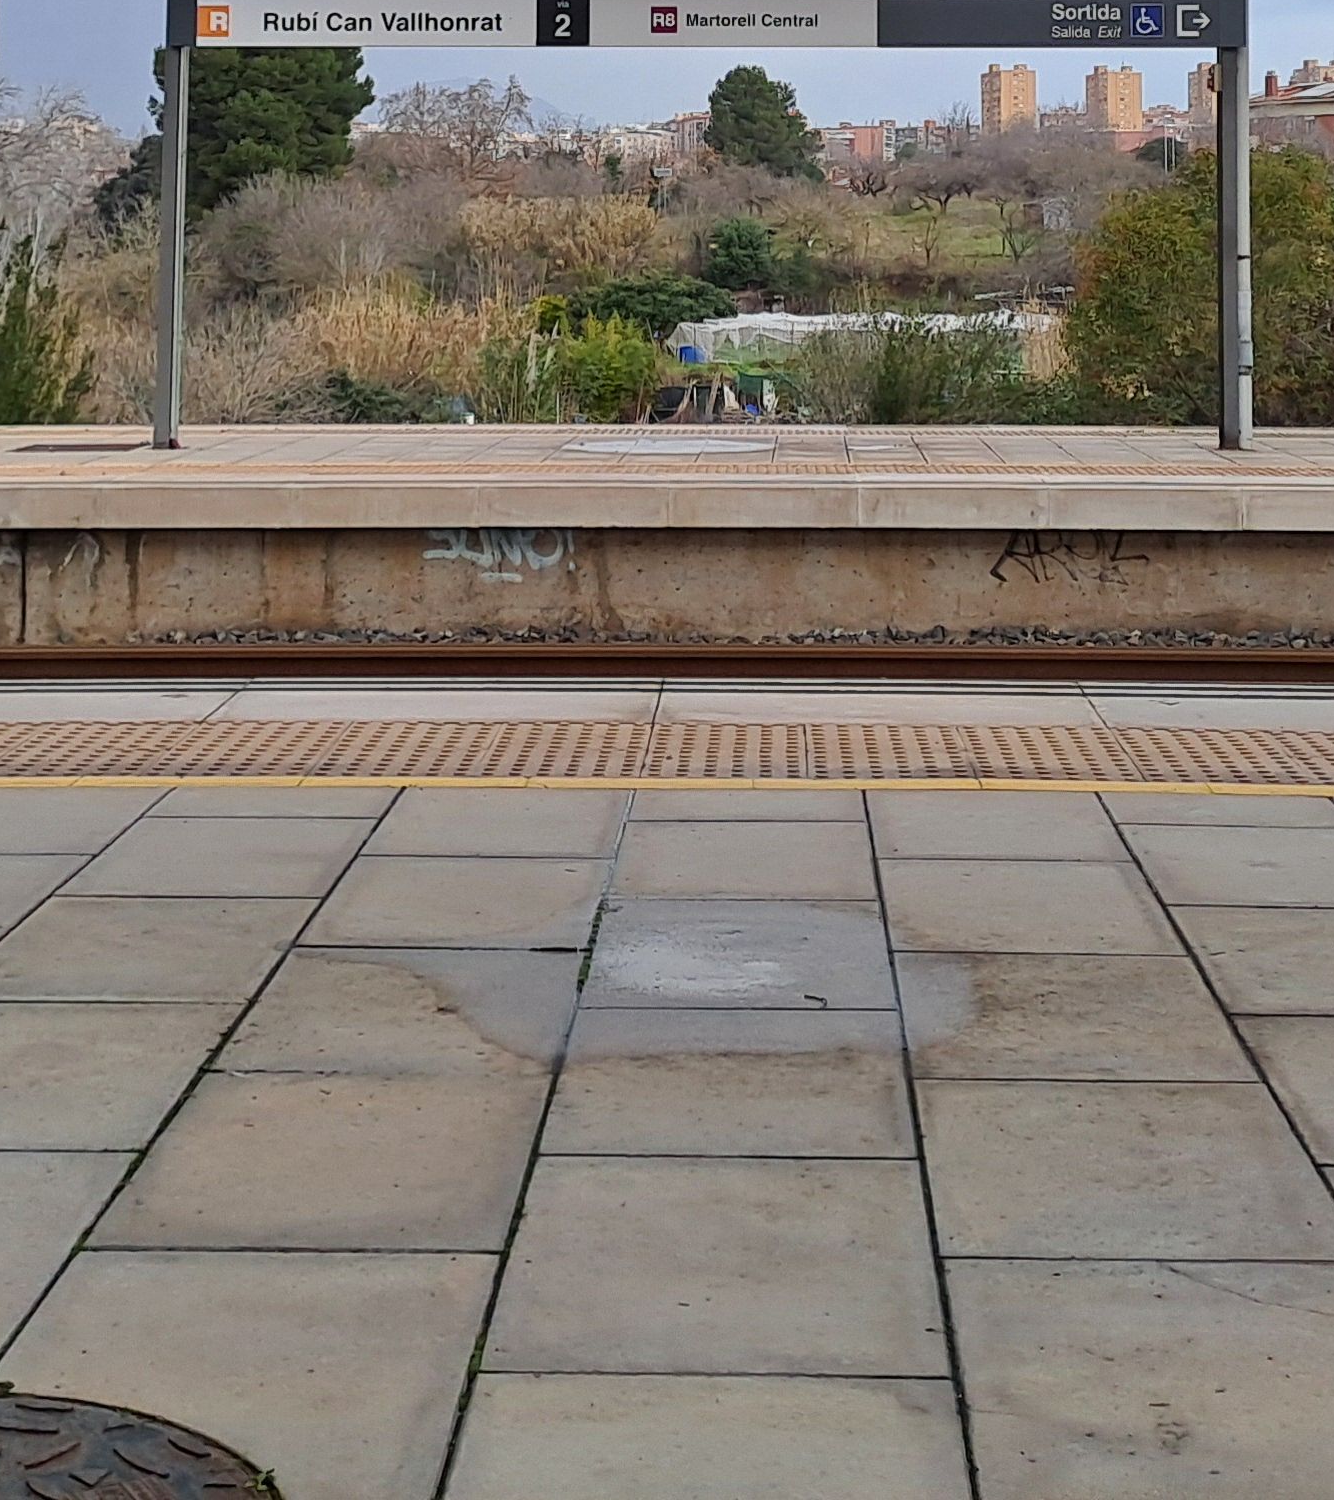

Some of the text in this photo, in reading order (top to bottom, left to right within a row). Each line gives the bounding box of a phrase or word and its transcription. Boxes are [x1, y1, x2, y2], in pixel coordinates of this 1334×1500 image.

[652, 12, 676, 28] R8
[686, 13, 819, 28] Martorell Central
[1051, 3, 1121, 21] Sortida
[209, 11, 228, 32] R
[263, 11, 503, 32] Rubí Can Vallhonrat
[554, 14, 571, 37] 2
[1051, 25, 1122, 38] Salida Exit
